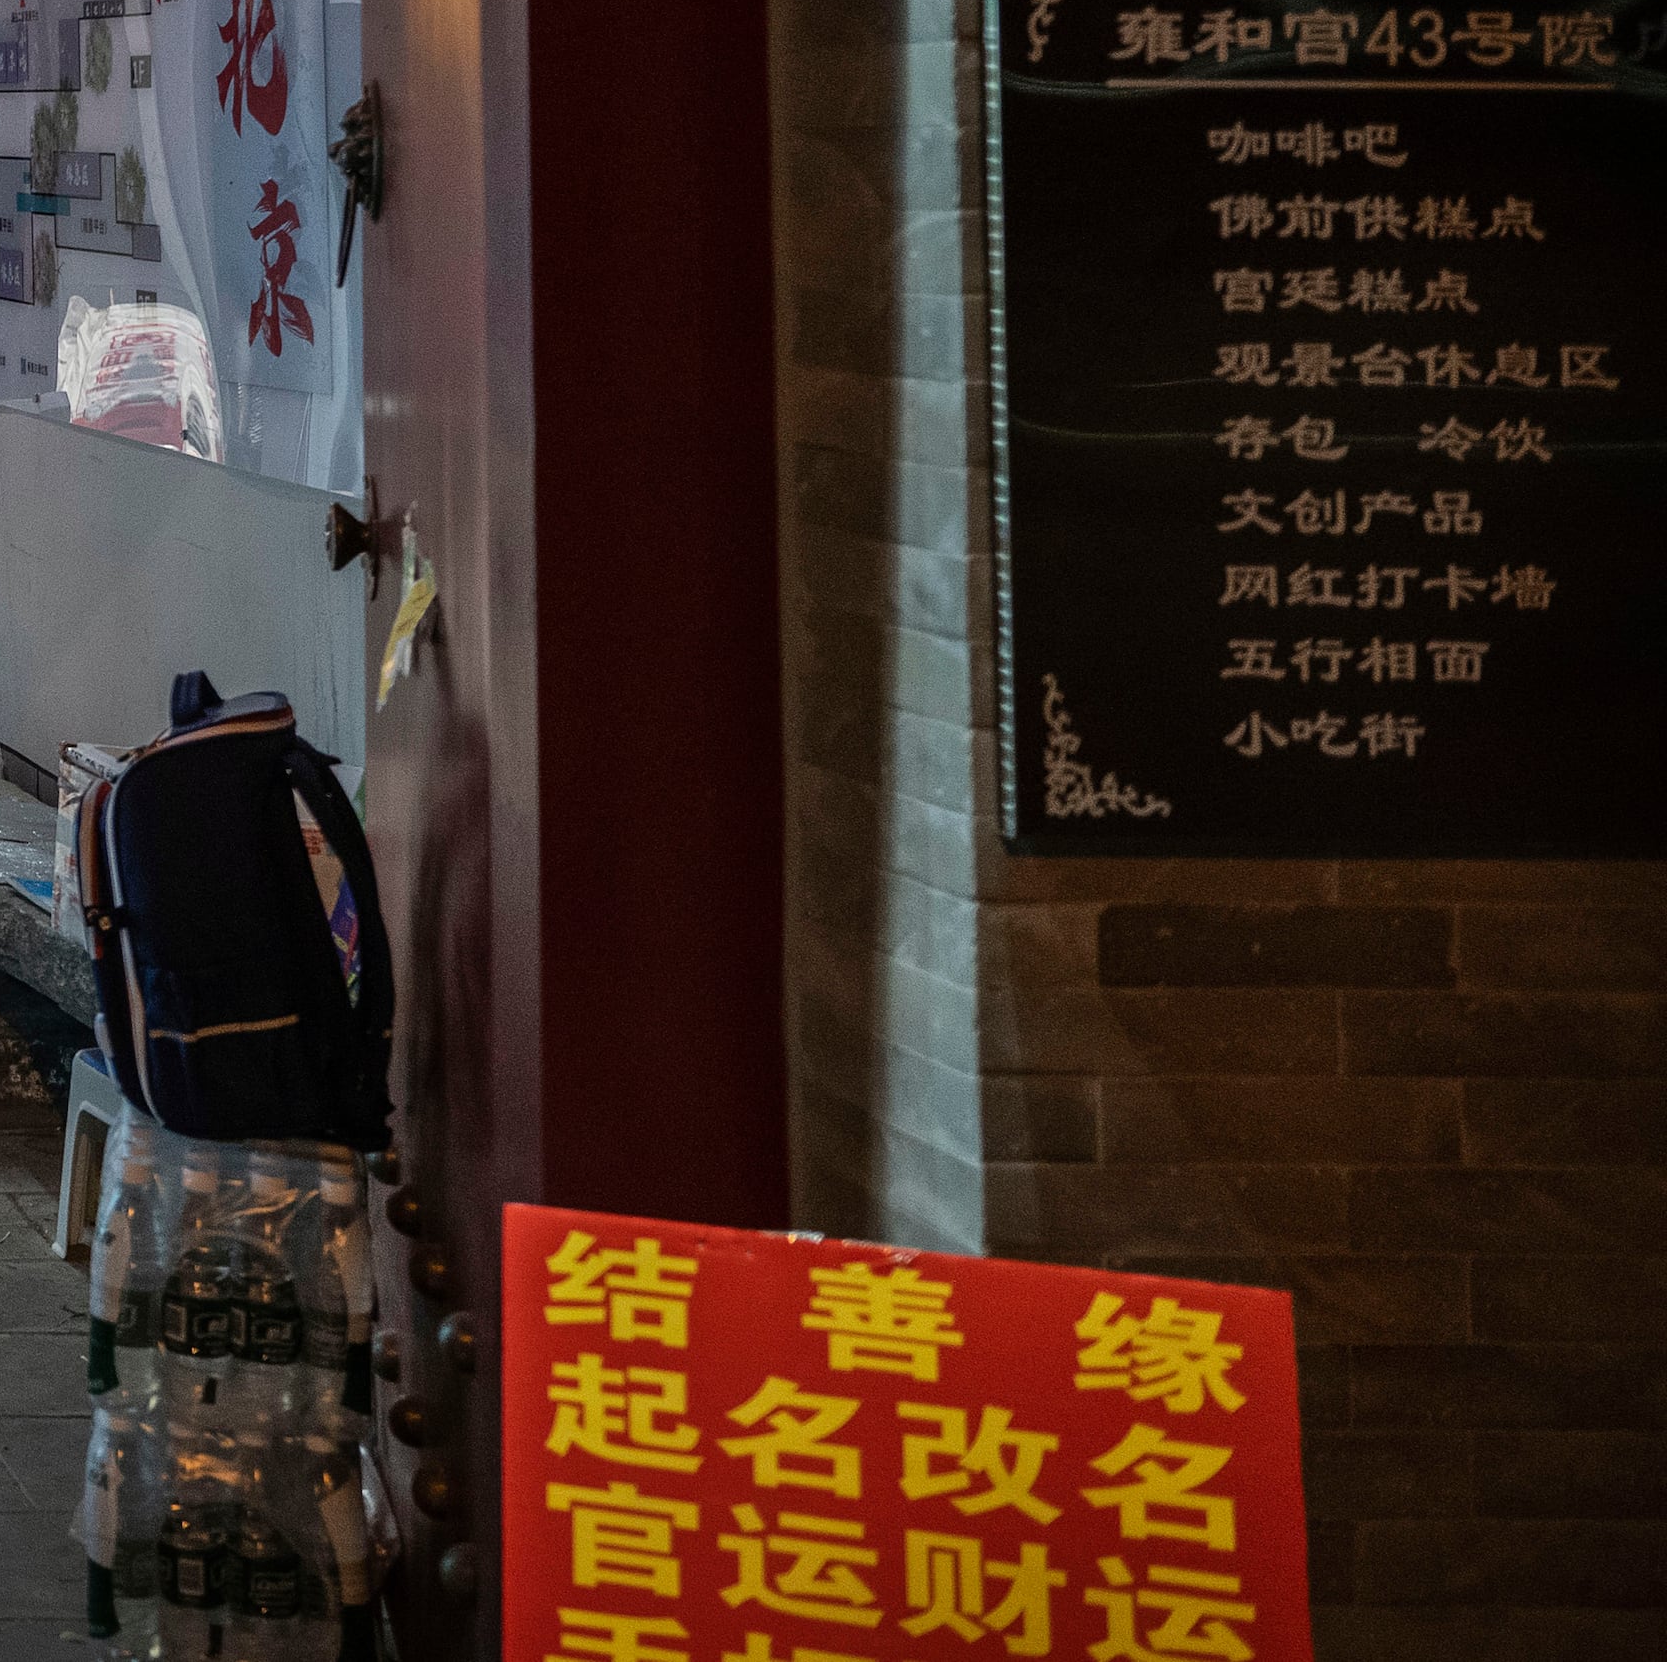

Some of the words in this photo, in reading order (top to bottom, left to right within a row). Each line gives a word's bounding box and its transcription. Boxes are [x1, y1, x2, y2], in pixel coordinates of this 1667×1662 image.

[1109, 7, 1617, 69] 雍和宫43号院
[1207, 122, 1408, 168] 咖啡吧
[1209, 195, 1546, 242] 佛前供糕点
[1213, 269, 1479, 315] 宫廷糕点
[1214, 344, 1620, 391] 观景台休息区
[1215, 416, 1349, 463] 存包
[1418, 416, 1554, 464] 冷饮
[1217, 489, 1485, 536] 文创产品
[1220, 564, 1557, 612] 网红打卡墙
[1220, 638, 1491, 684] 五行相面
[1223, 713, 1426, 760] 小吃街
[544, 1230, 1245, 1415] 结善缘
[545, 1352, 1237, 1552] 起名改名
[545, 1481, 1256, 1662] 官运财运
